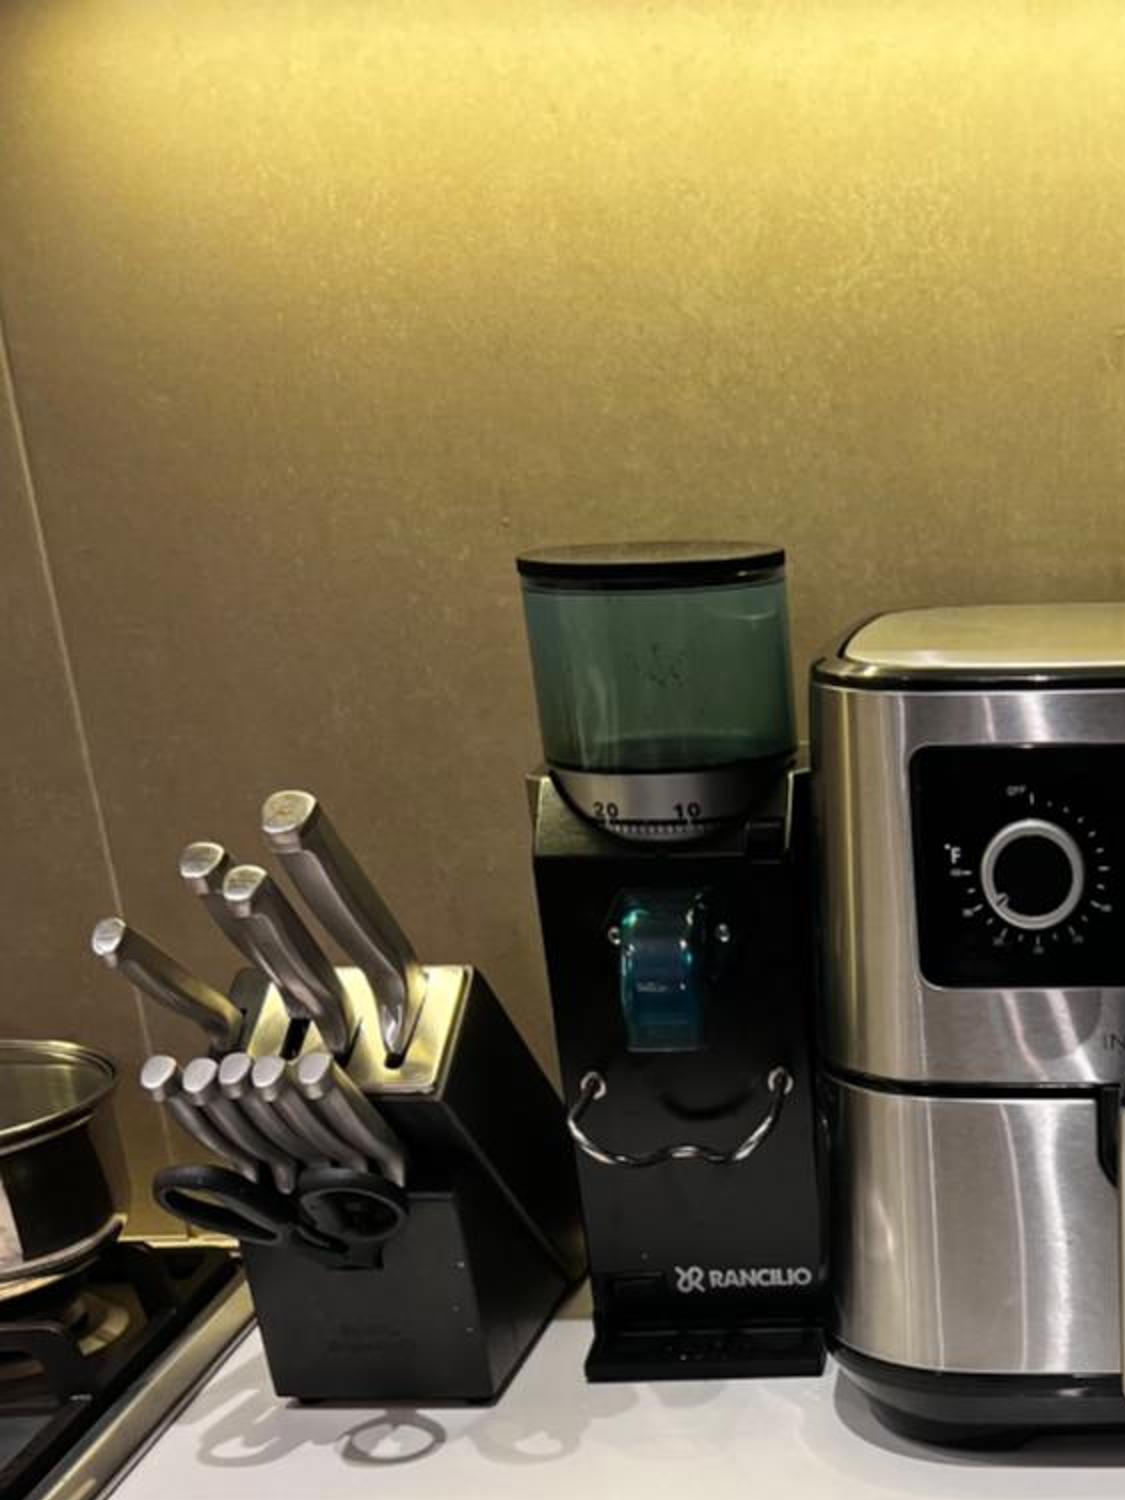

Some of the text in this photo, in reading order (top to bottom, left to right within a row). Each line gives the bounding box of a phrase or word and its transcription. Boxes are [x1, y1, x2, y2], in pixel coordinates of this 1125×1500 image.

[593, 801, 701, 818] 20 10
[708, 1267, 813, 1288] RANCILIO
